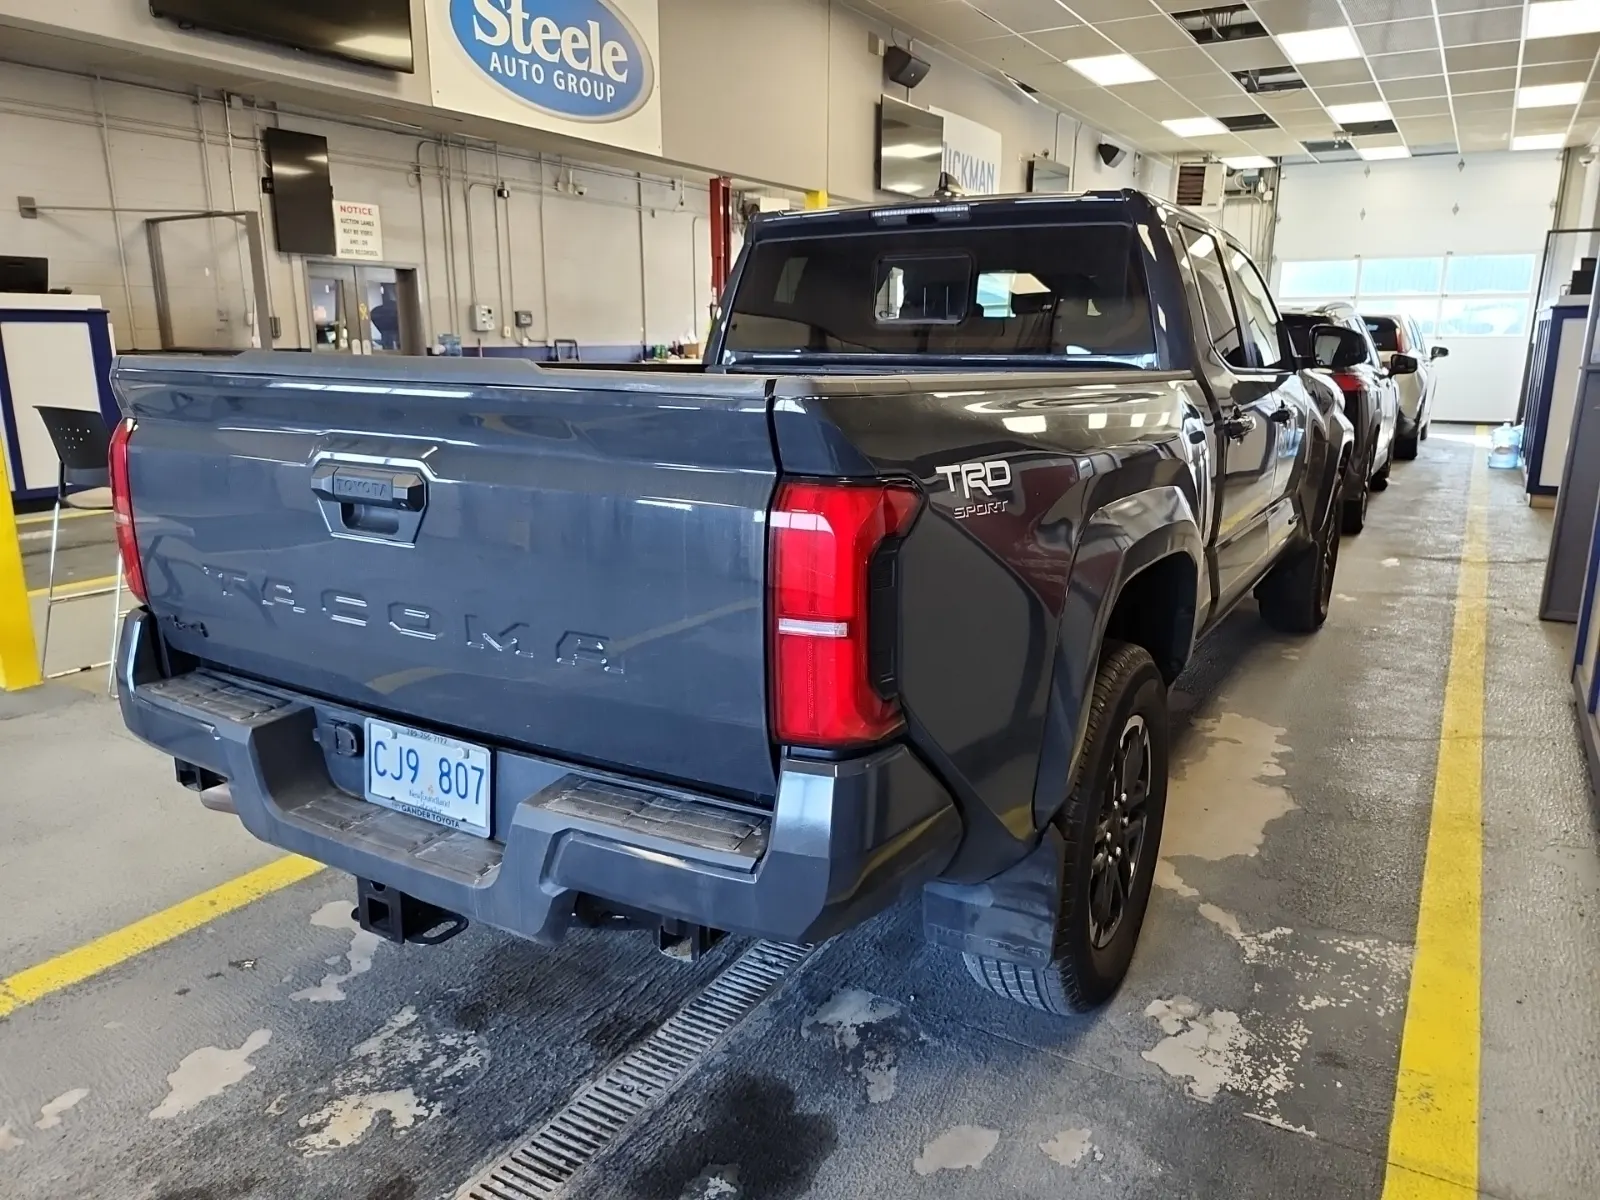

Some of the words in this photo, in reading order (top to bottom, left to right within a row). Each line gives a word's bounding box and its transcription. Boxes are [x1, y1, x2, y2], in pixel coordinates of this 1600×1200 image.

[473, 0, 629, 84] Steele
[489, 51, 545, 85] AUTO
[553, 70, 616, 103] GROUP
[340, 205, 373, 216] NOTICE
[336, 478, 389, 497] TOYOTA
[935, 460, 1012, 499] TRD
[954, 500, 1009, 519] SPORT
[201, 563, 627, 674] TACOMA
[374, 740, 420, 784] CJ9
[438, 757, 485, 805] 807
[401, 804, 431, 819] GANDER
[431, 813, 461, 829] TOYOTA
